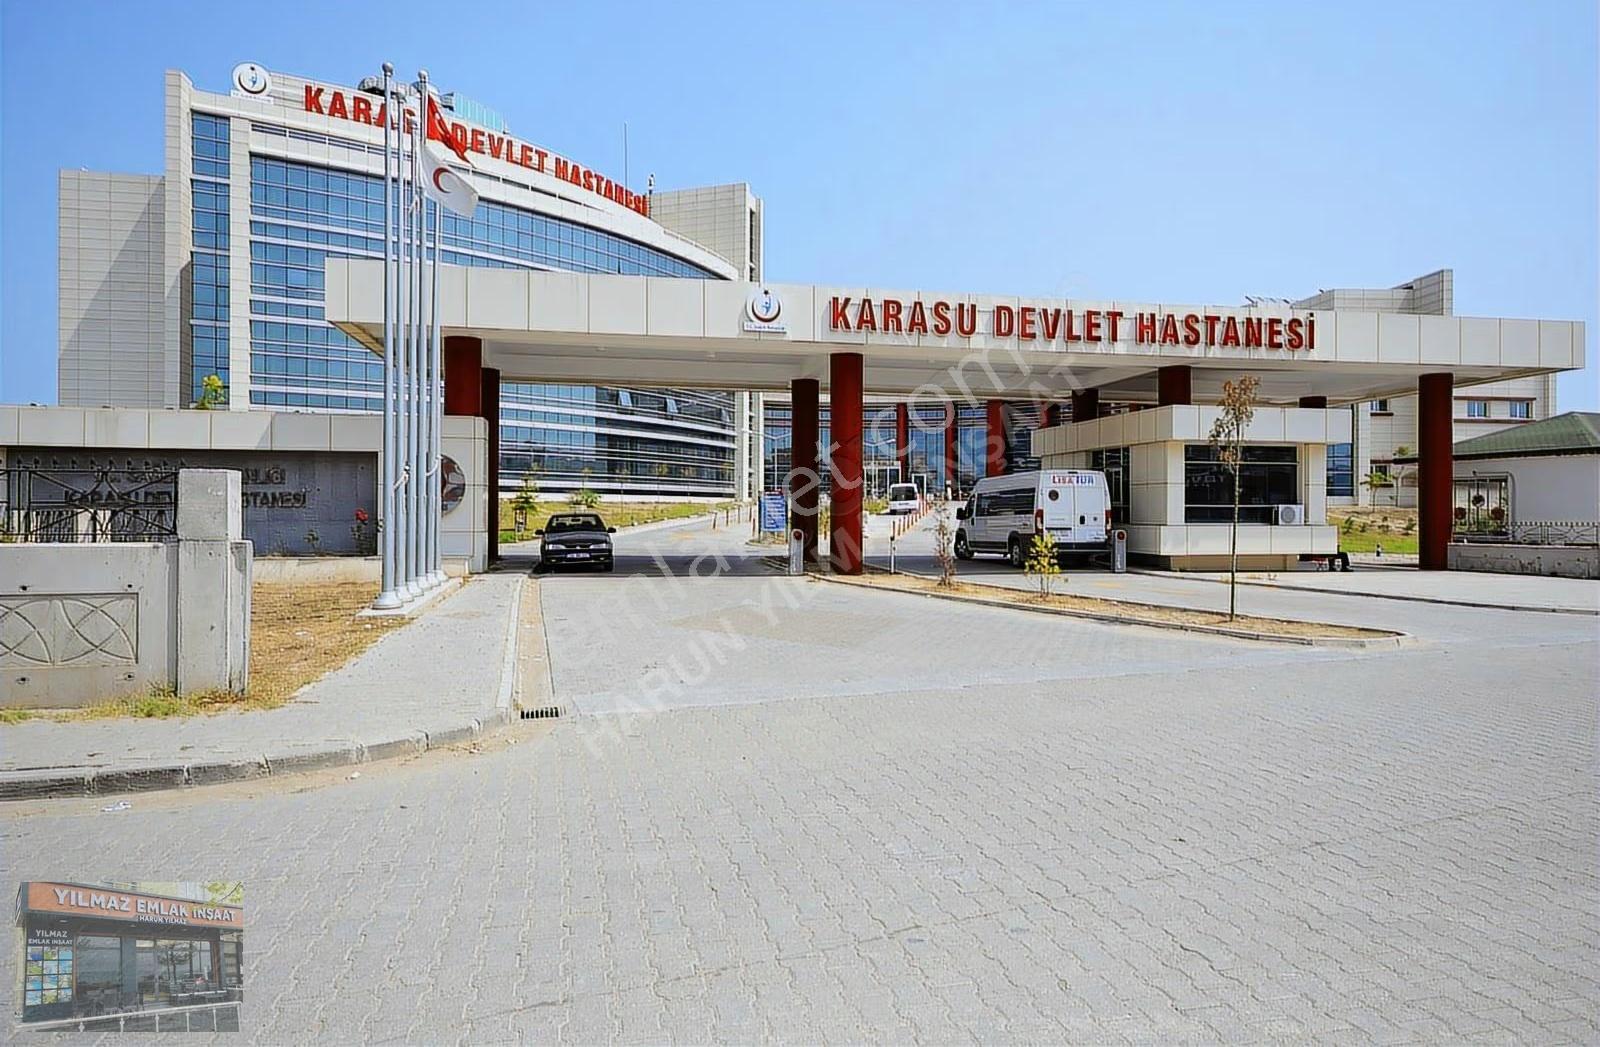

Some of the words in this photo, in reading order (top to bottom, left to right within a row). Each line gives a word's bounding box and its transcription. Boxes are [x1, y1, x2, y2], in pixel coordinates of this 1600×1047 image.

[451, 121, 548, 173] DEVLET
[830, 296, 978, 337] KARASU
[994, 304, 1124, 344] DEVLET
[1136, 311, 1316, 350] HASTANESİ
